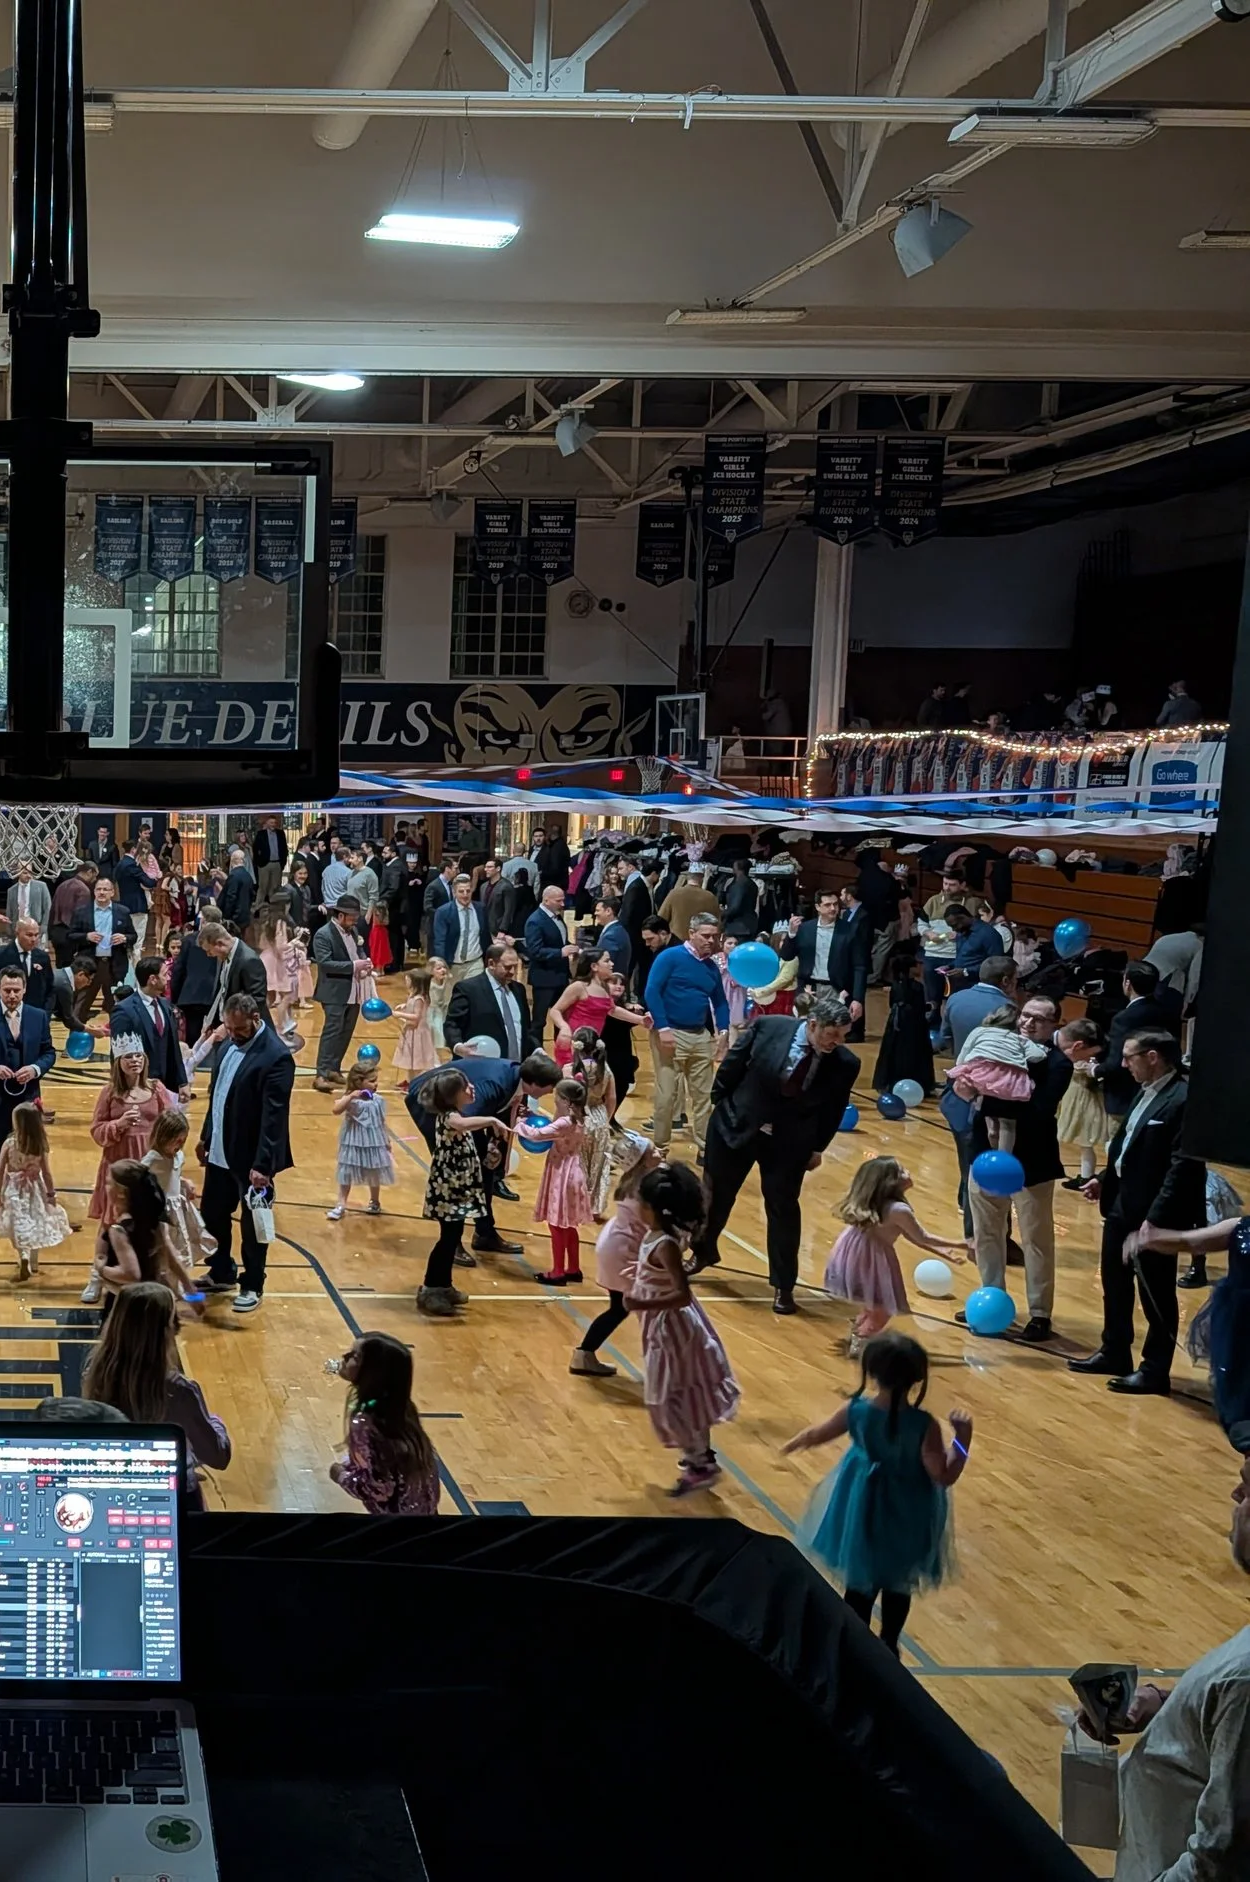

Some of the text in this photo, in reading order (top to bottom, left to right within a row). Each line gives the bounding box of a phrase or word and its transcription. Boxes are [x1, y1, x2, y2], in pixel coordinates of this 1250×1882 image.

[718, 455, 751, 463] VARSITY
[830, 456, 863, 464] VARSITY
[713, 471, 756, 479] ICE HOCKEY
[711, 488, 750, 496] DIVISION
[823, 489, 860, 497] DIVISION
[890, 490, 928, 498] DIVISION
[719, 497, 747, 505] STATE
[707, 506, 759, 514] CHAMPIONS
[819, 507, 870, 515] RUNNER-UP
[884, 508, 937, 516] CHAMPIONS
[721, 515, 743, 523] 2025
[832, 516, 853, 524] 2024
[898, 517, 919, 525] 2024
[1157, 769, 1166, 781] Go
